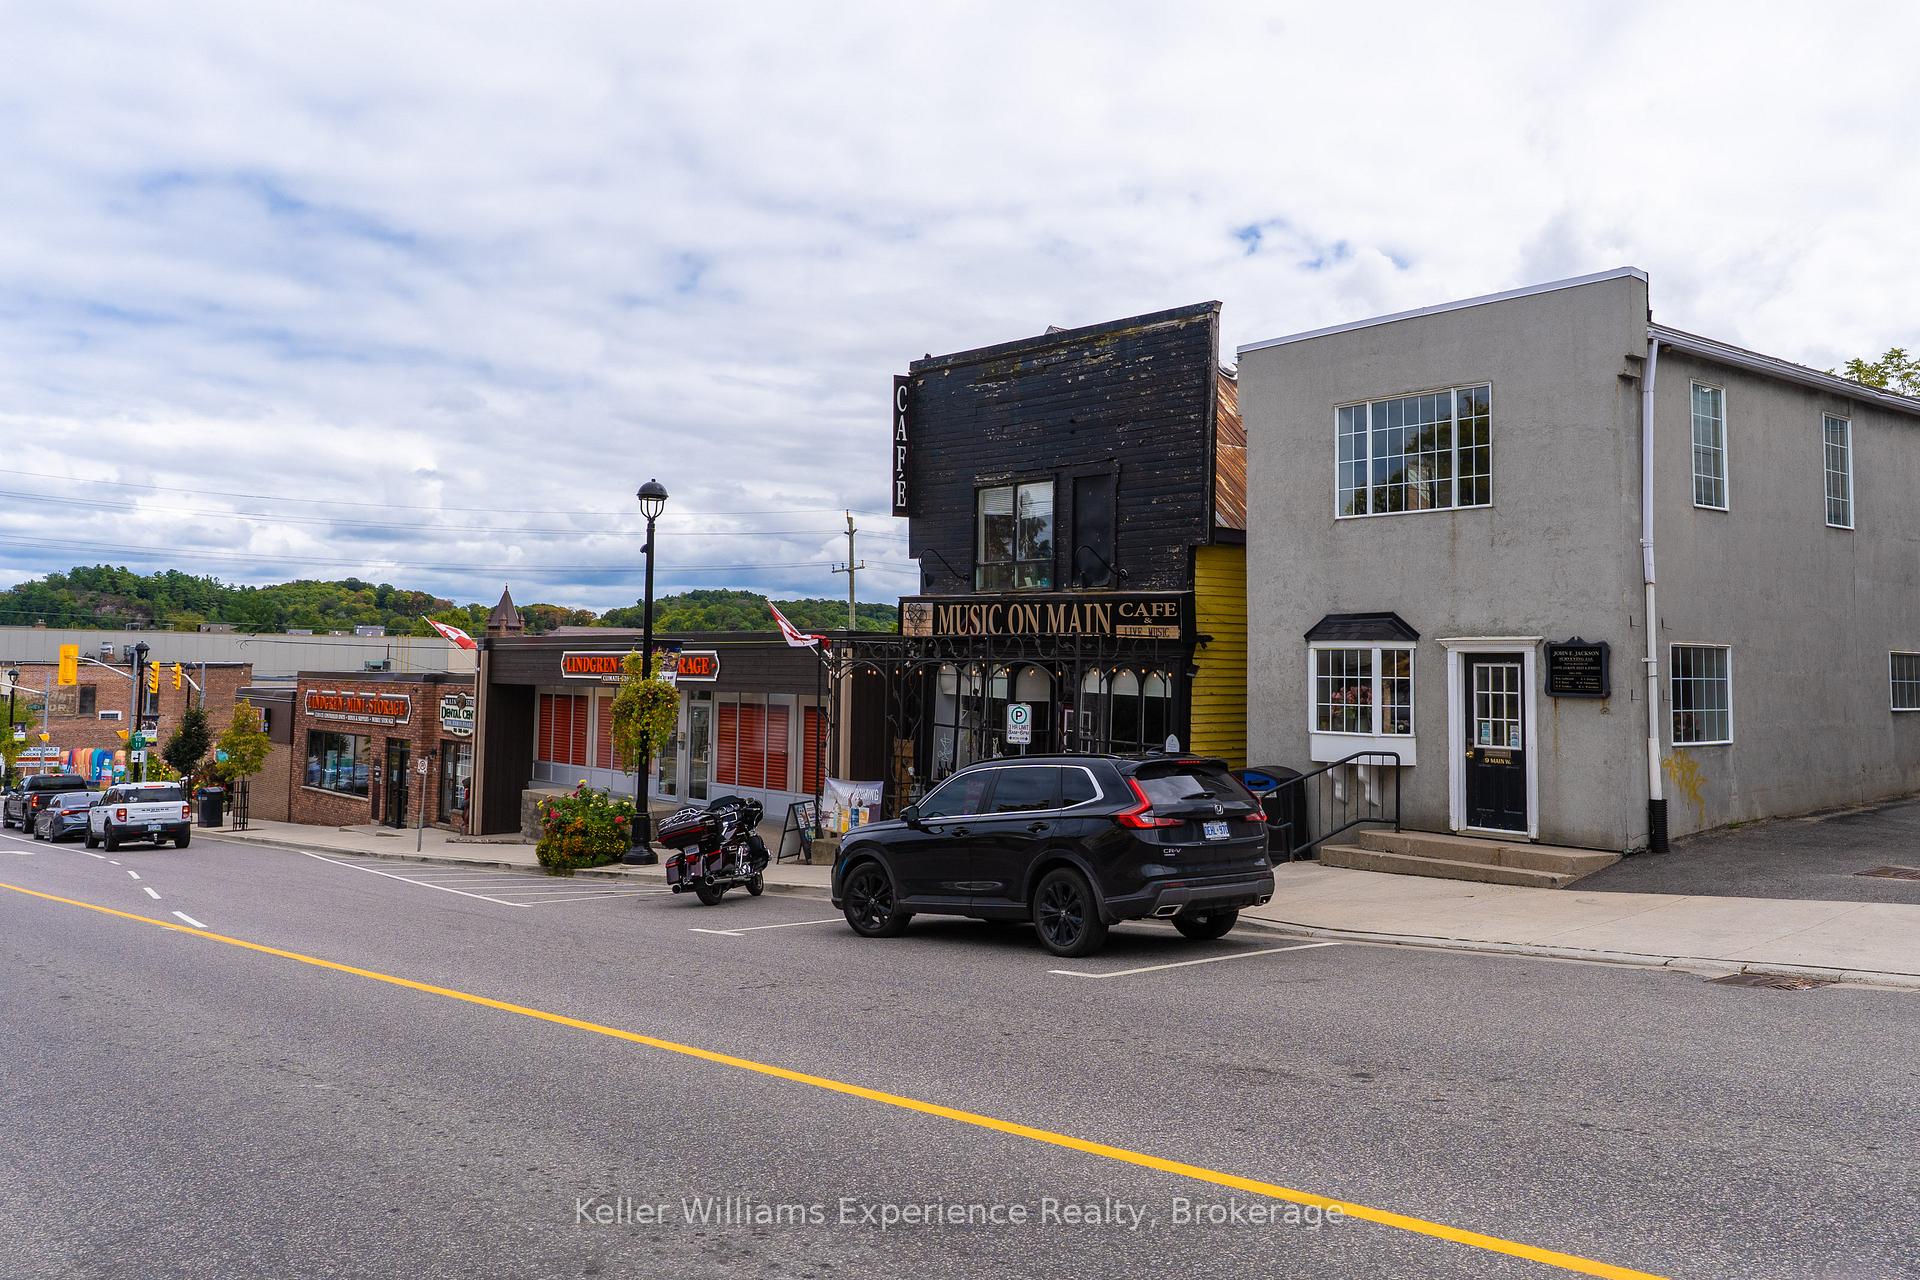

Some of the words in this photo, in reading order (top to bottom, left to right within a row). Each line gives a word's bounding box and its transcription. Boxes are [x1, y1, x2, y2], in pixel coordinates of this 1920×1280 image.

[1118, 602, 1178, 617] CAFE
[937, 604, 1003, 636] MUSIC
[1007, 603, 1041, 636] ON
[1046, 603, 1113, 637] MAIN
[1124, 627, 1143, 636] LIVE
[1148, 627, 1170, 638] MUSIC
[566, 656, 619, 673] LINDGREN
[679, 656, 711, 674] RAGE
[307, 695, 344, 711] LINDGREN
[368, 699, 406, 716] STORAGE
